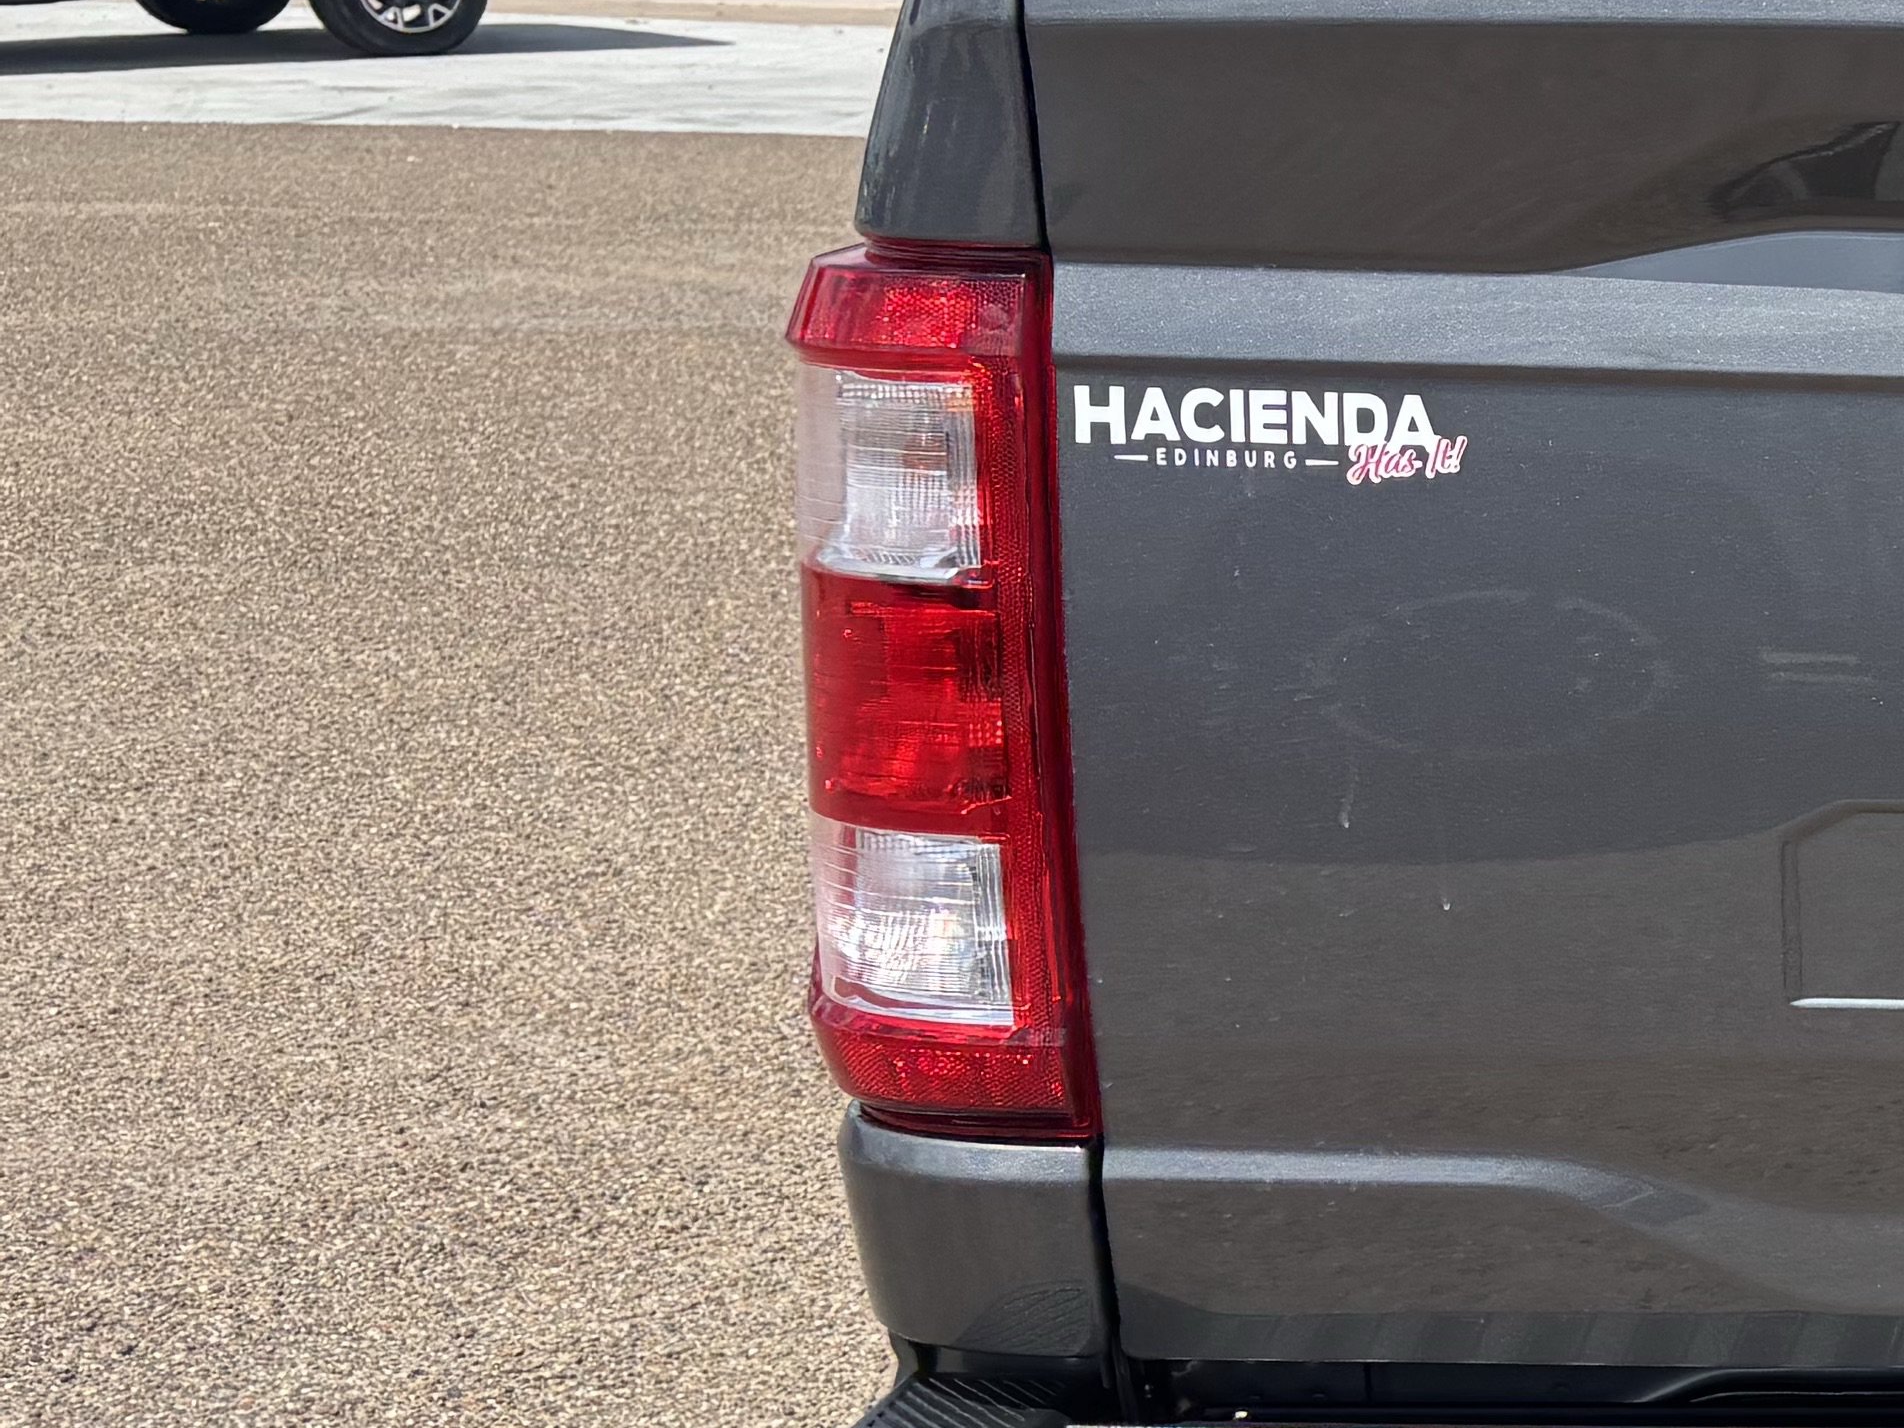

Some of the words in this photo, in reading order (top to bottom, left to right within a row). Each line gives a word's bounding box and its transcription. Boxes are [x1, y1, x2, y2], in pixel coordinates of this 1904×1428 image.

[1073, 384, 1440, 447] HACIENDA
[1155, 447, 1298, 469] EDINBURG
[1346, 439, 1424, 486] Has
